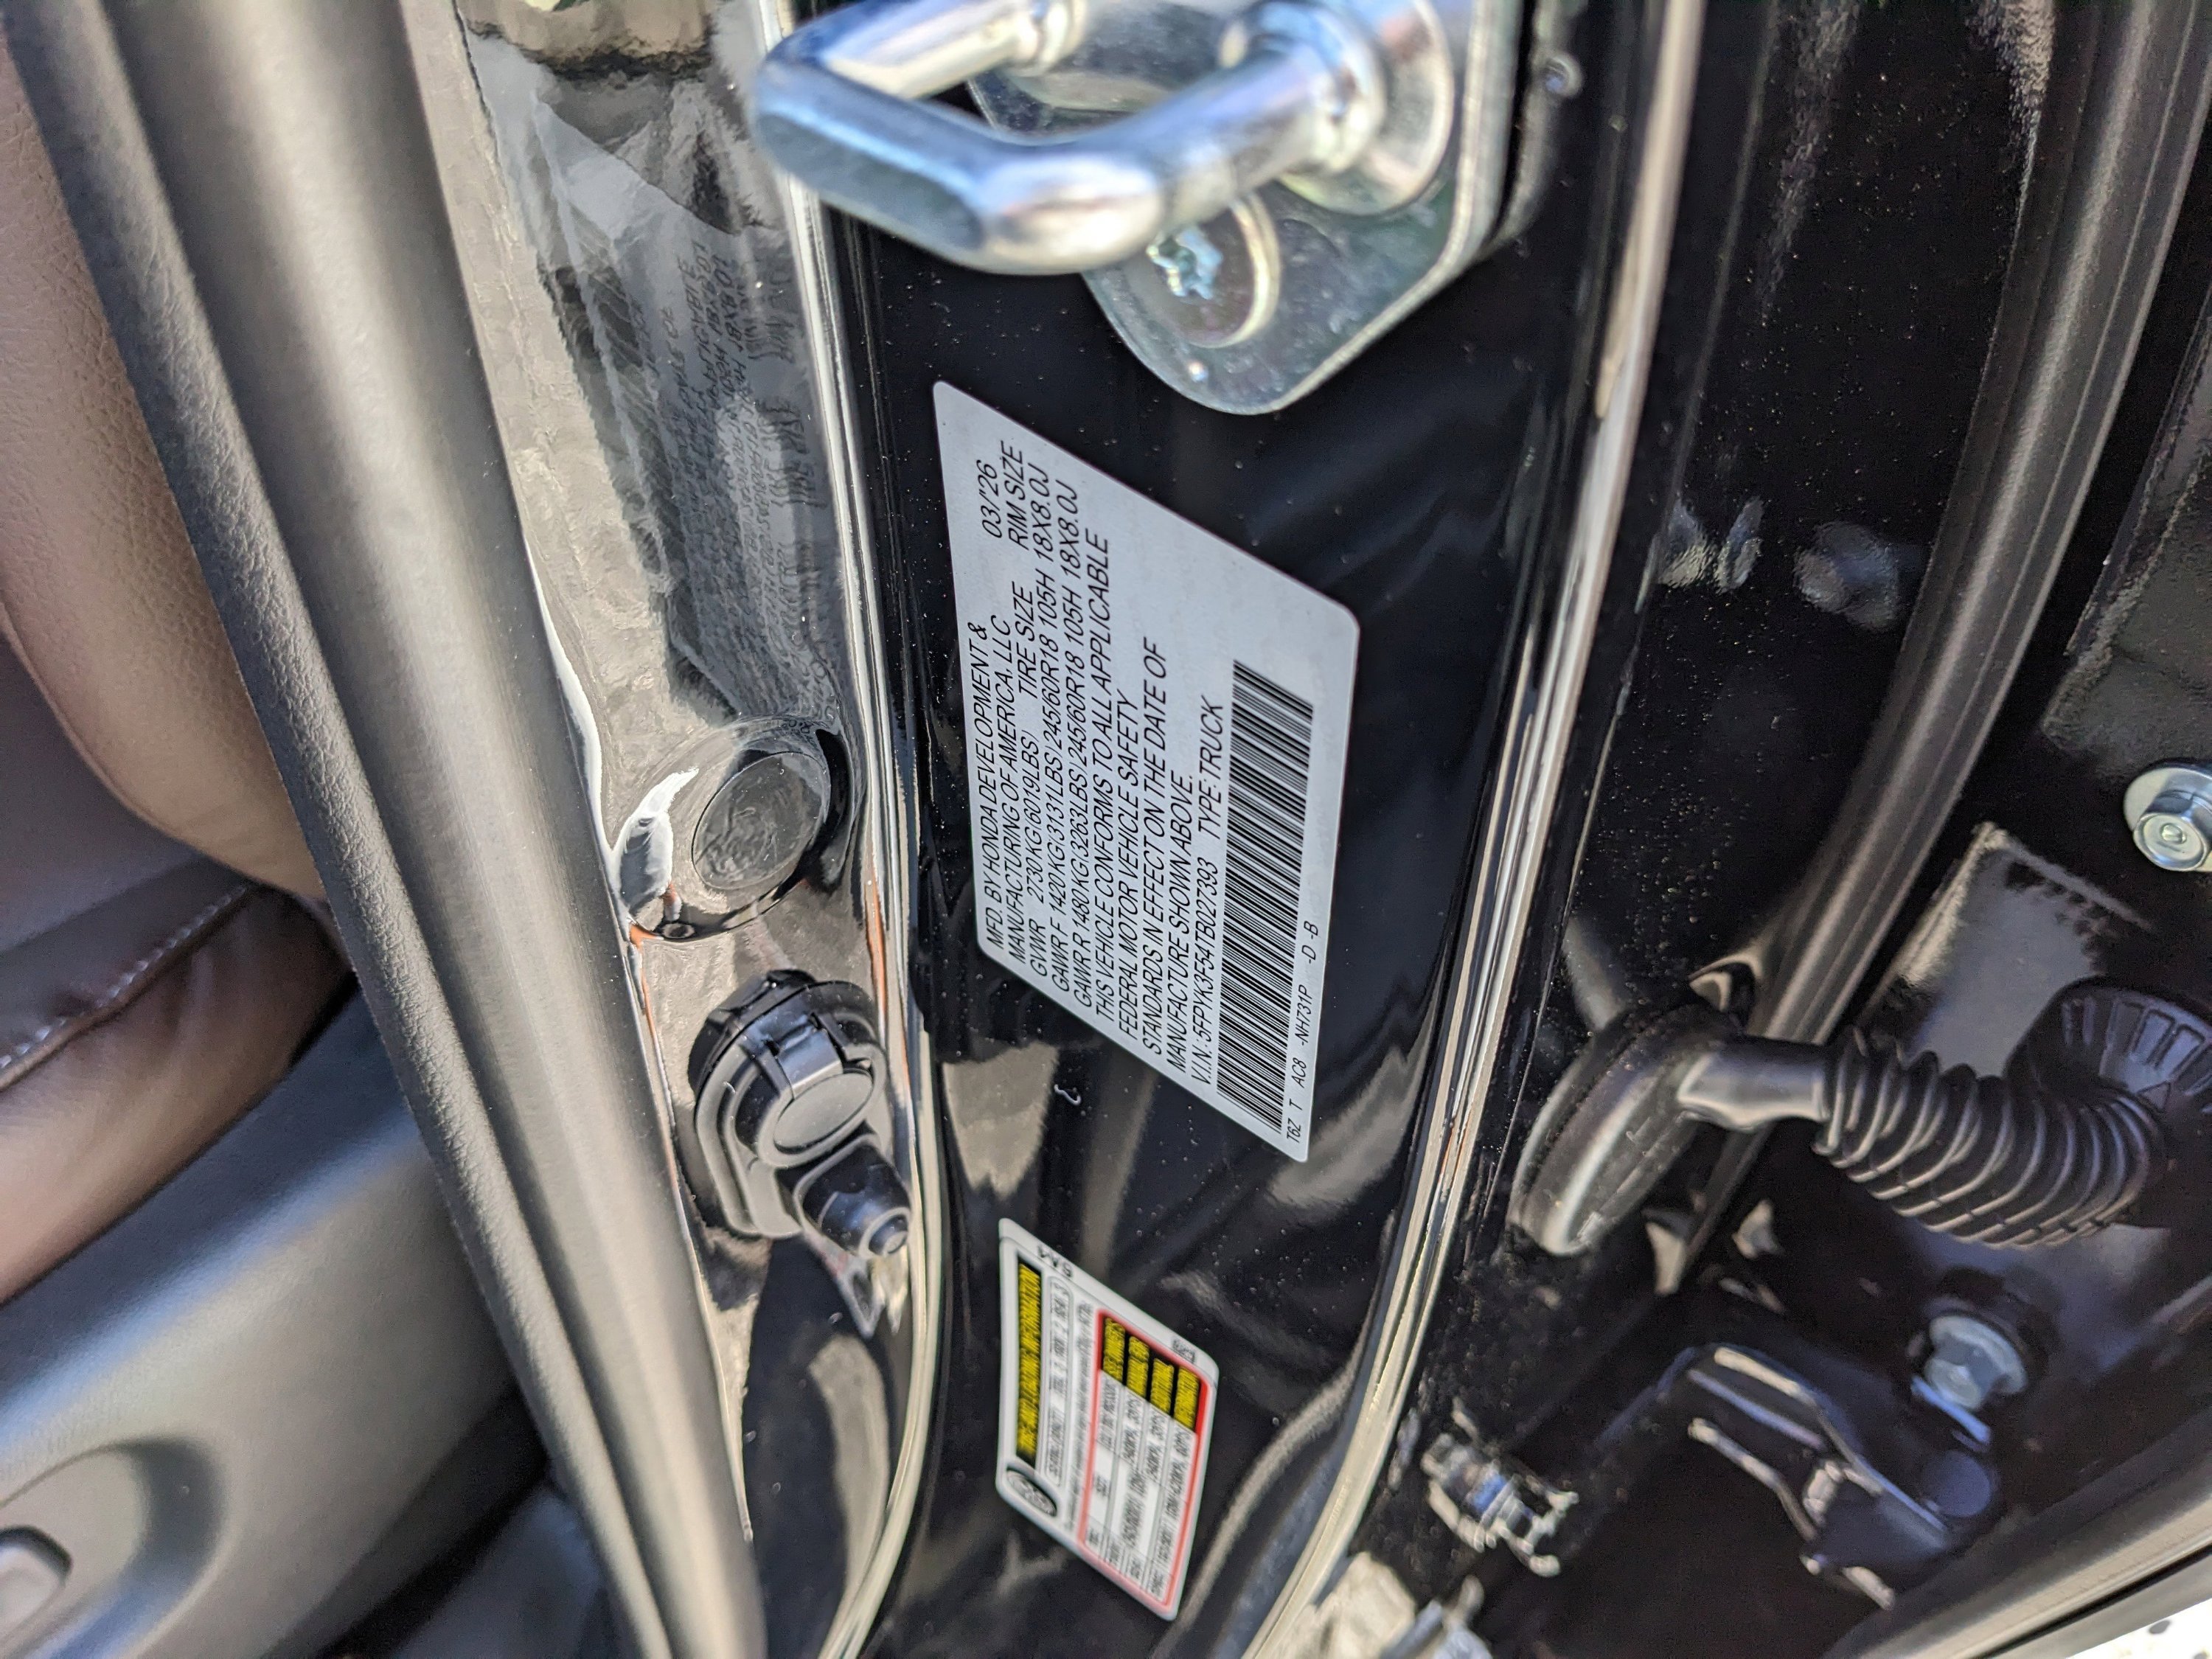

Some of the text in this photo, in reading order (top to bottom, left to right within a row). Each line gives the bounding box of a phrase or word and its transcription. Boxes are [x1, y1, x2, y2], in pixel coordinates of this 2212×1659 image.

[975, 459, 1003, 539] 03/'26
[1000, 439, 1029, 551] RIM SIZE
[1027, 462, 1054, 563] 18X8.0J
[1055, 479, 1081, 580] 18X8.0J
[1034, 568, 1057, 630] 105H
[1061, 585, 1084, 647] 105H
[1011, 580, 1038, 700] TIRE SIZE
[1039, 633, 1062, 751] 245/60R18
[1064, 650, 1088, 768] 245/60R18
[967, 622, 1004, 950] MFD. BY HONDA DEVELOPMENT &
[990, 614, 1026, 964] MANUFACTURING OF AMERICA, LLC
[1085, 527, 1115, 1022] THIS VEHICLE CONFORMS TO ALL APPLICABLE
[1025, 856, 1044, 905] 2730
[1116, 688, 1138, 1040] FEDERAL MOTOR VEHICLE SAFETY
[1142, 636, 1167, 1055] STANDARDS IN EFFECT ON THE DATE OF
[1048, 872, 1067, 916] 1420
[1049, 916, 1068, 937] F
[1071, 888, 1091, 932] 1480
[1166, 769, 1193, 1074] MANUFACTURE SHOWN ABOVE.
[1028, 918, 1048, 977] GVWR
[1050, 933, 1070, 992] GAWR
[1072, 931, 1091, 953] R
[1073, 949, 1093, 1008] GAWR
[1192, 857, 1218, 1043] 5FPYK3F54TB027393
[1289, 1098, 1303, 1111] T
[1291, 1057, 1307, 1089] AC8
[1286, 1117, 1301, 1144] T6Z
